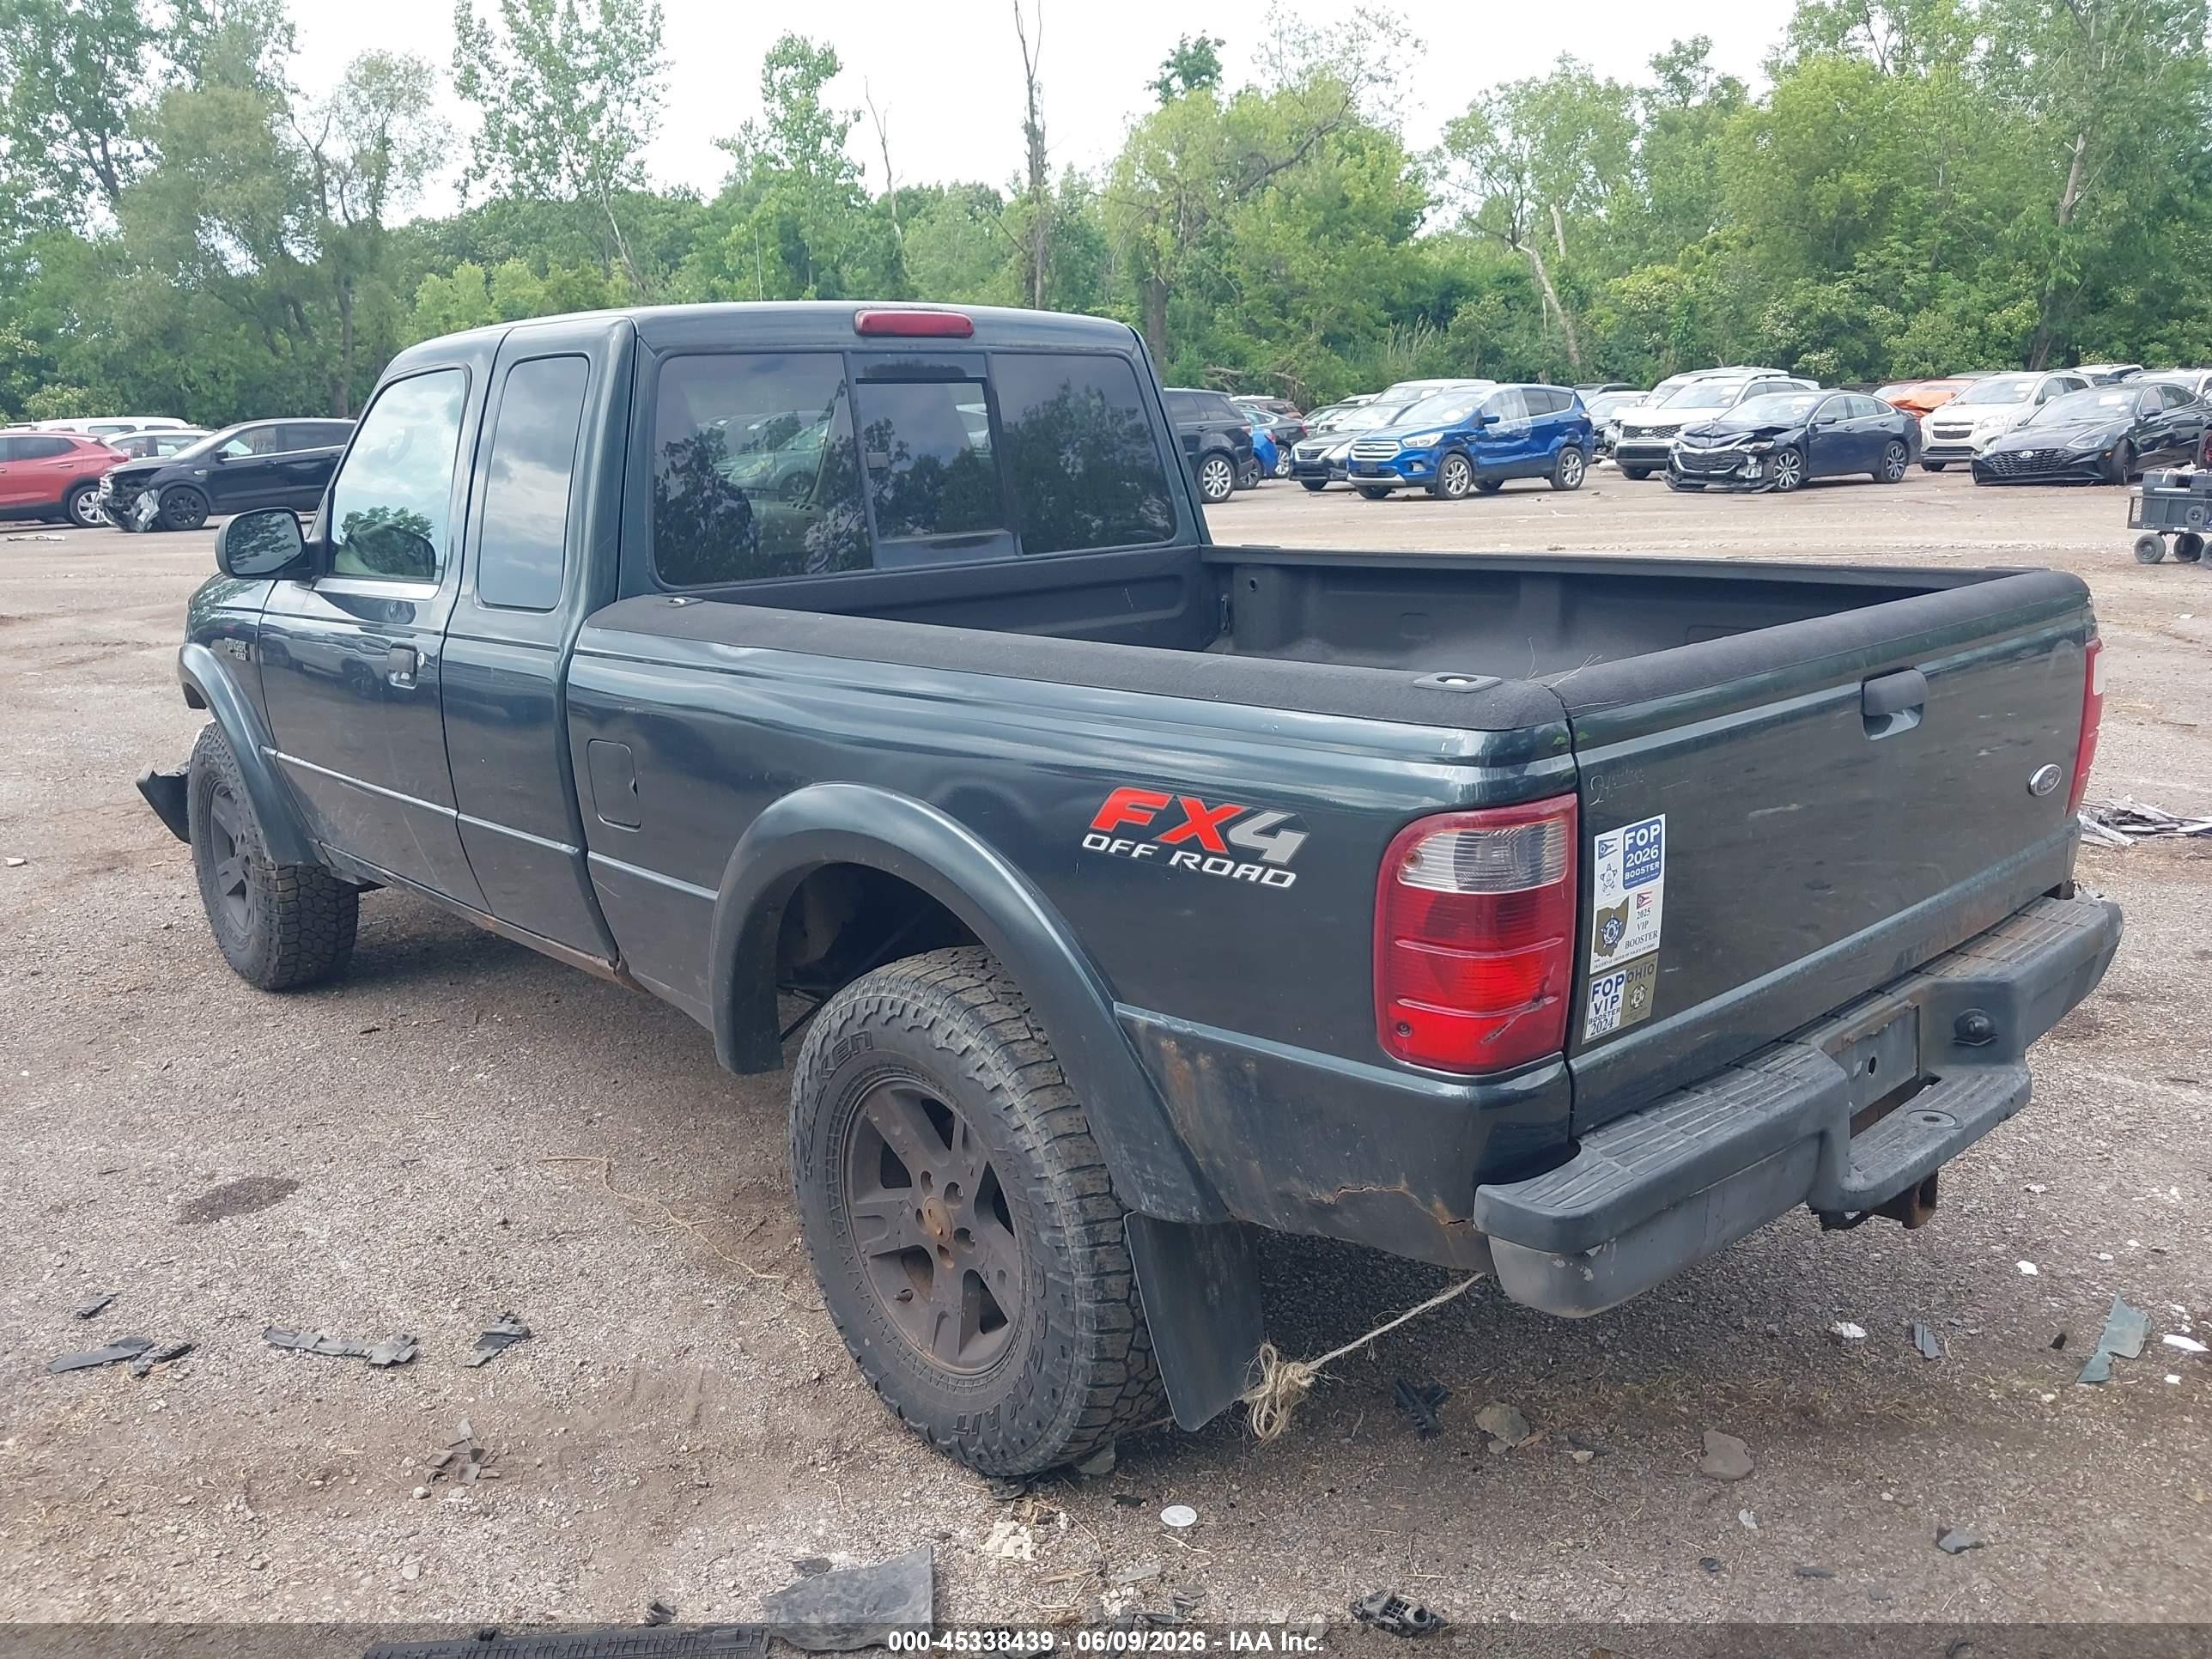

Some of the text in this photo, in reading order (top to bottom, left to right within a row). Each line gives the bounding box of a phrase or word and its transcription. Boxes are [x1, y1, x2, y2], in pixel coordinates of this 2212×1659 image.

[1088, 786, 1310, 866] FX4
[1625, 823, 1661, 852] FOP
[1082, 832, 1297, 889] OFF ROAD
[1626, 844, 1659, 868] 2026
[1624, 861, 1660, 880] BOOSTER
[1637, 908, 1650, 920] 2025
[1637, 920, 1649, 932] VIP
[1625, 930, 1659, 950] BOOSTER
[1626, 963, 1655, 984] OHIO
[1591, 973, 1625, 1003] FOP
[1588, 1006, 1621, 1024] BOOSTER
[1594, 994, 1620, 1015] VIP
[1590, 1016, 1614, 1036] 2024
